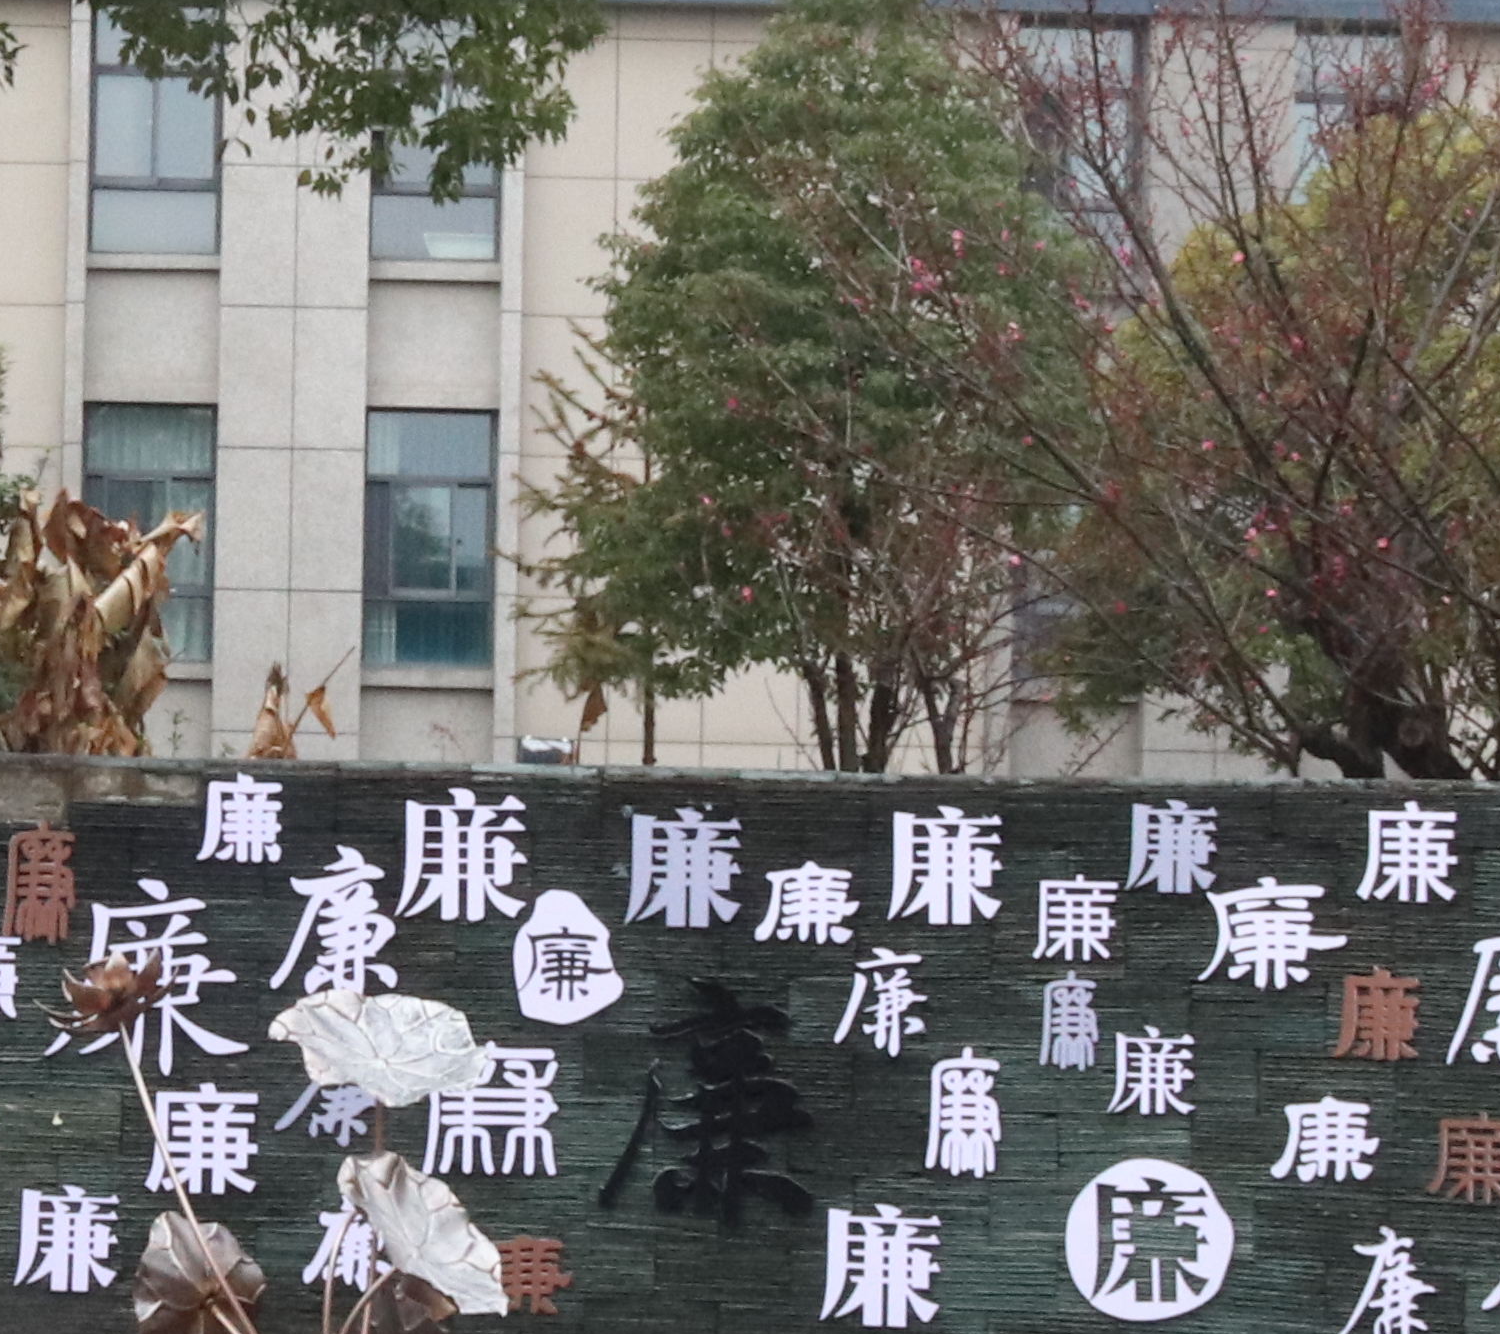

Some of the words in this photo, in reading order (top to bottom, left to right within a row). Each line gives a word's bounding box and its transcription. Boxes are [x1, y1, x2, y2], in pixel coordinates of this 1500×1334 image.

[196, 772, 283, 863] 廉
[394, 787, 528, 922] 廉
[625, 805, 742, 928] 廉
[887, 805, 1002, 925] 廉
[1125, 799, 1218, 894] 廉
[1356, 801, 1458, 904] 廉
[754, 860, 860, 945] 廉
[1032, 873, 1119, 962] 廉
[1197, 876, 1348, 990] 廉
[518, 927, 614, 1001] 廉
[833, 947, 928, 1058] 廉
[1332, 966, 1419, 1061] 廉
[1107, 1025, 1195, 1115] 廉
[144, 1082, 259, 1195] 廉
[1270, 1095, 1380, 1183] 廉
[13, 1185, 120, 1292] 廉
[819, 1203, 941, 1328] 廉
[1090, 1177, 1209, 1303] 廉
